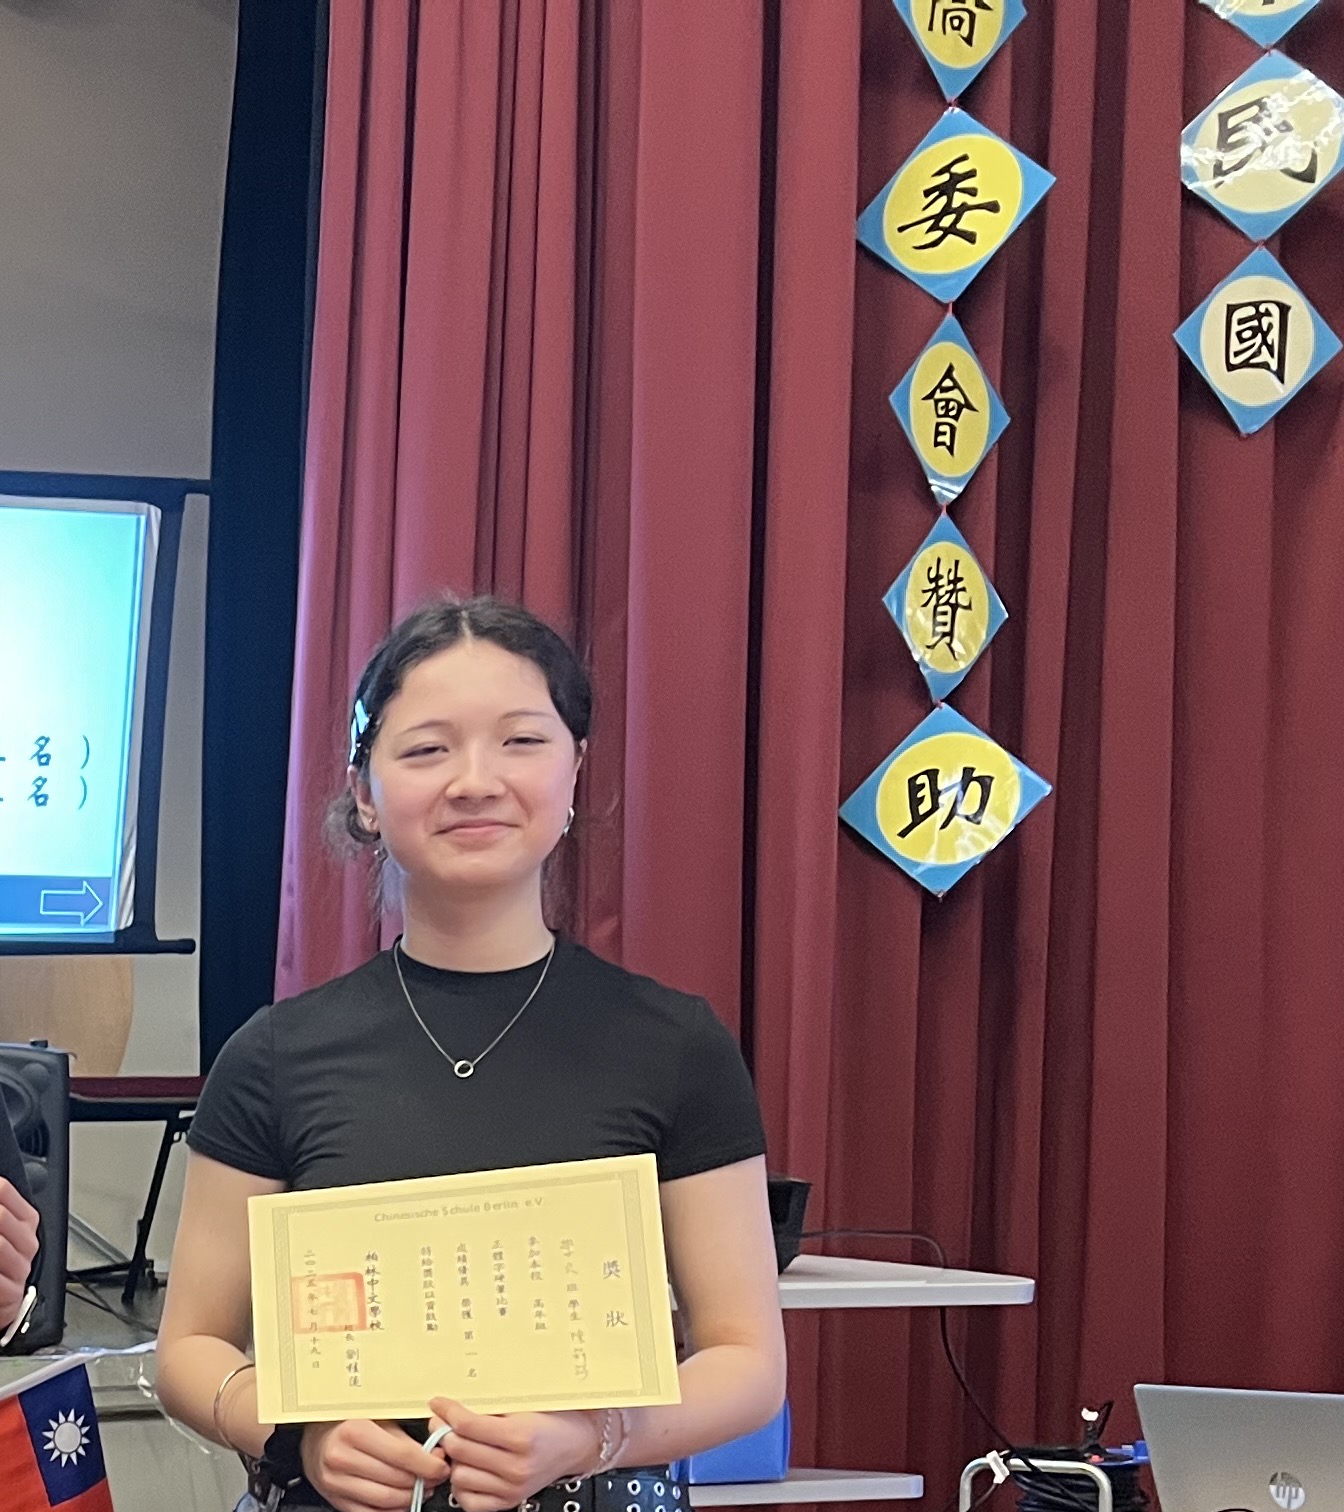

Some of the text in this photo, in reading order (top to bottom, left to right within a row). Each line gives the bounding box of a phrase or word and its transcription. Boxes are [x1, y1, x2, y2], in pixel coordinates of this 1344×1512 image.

[1213, 0, 1317, 385] 民國
[484, 1200, 519, 1212] Berlin
[603, 1259, 629, 1328] 獎狀
